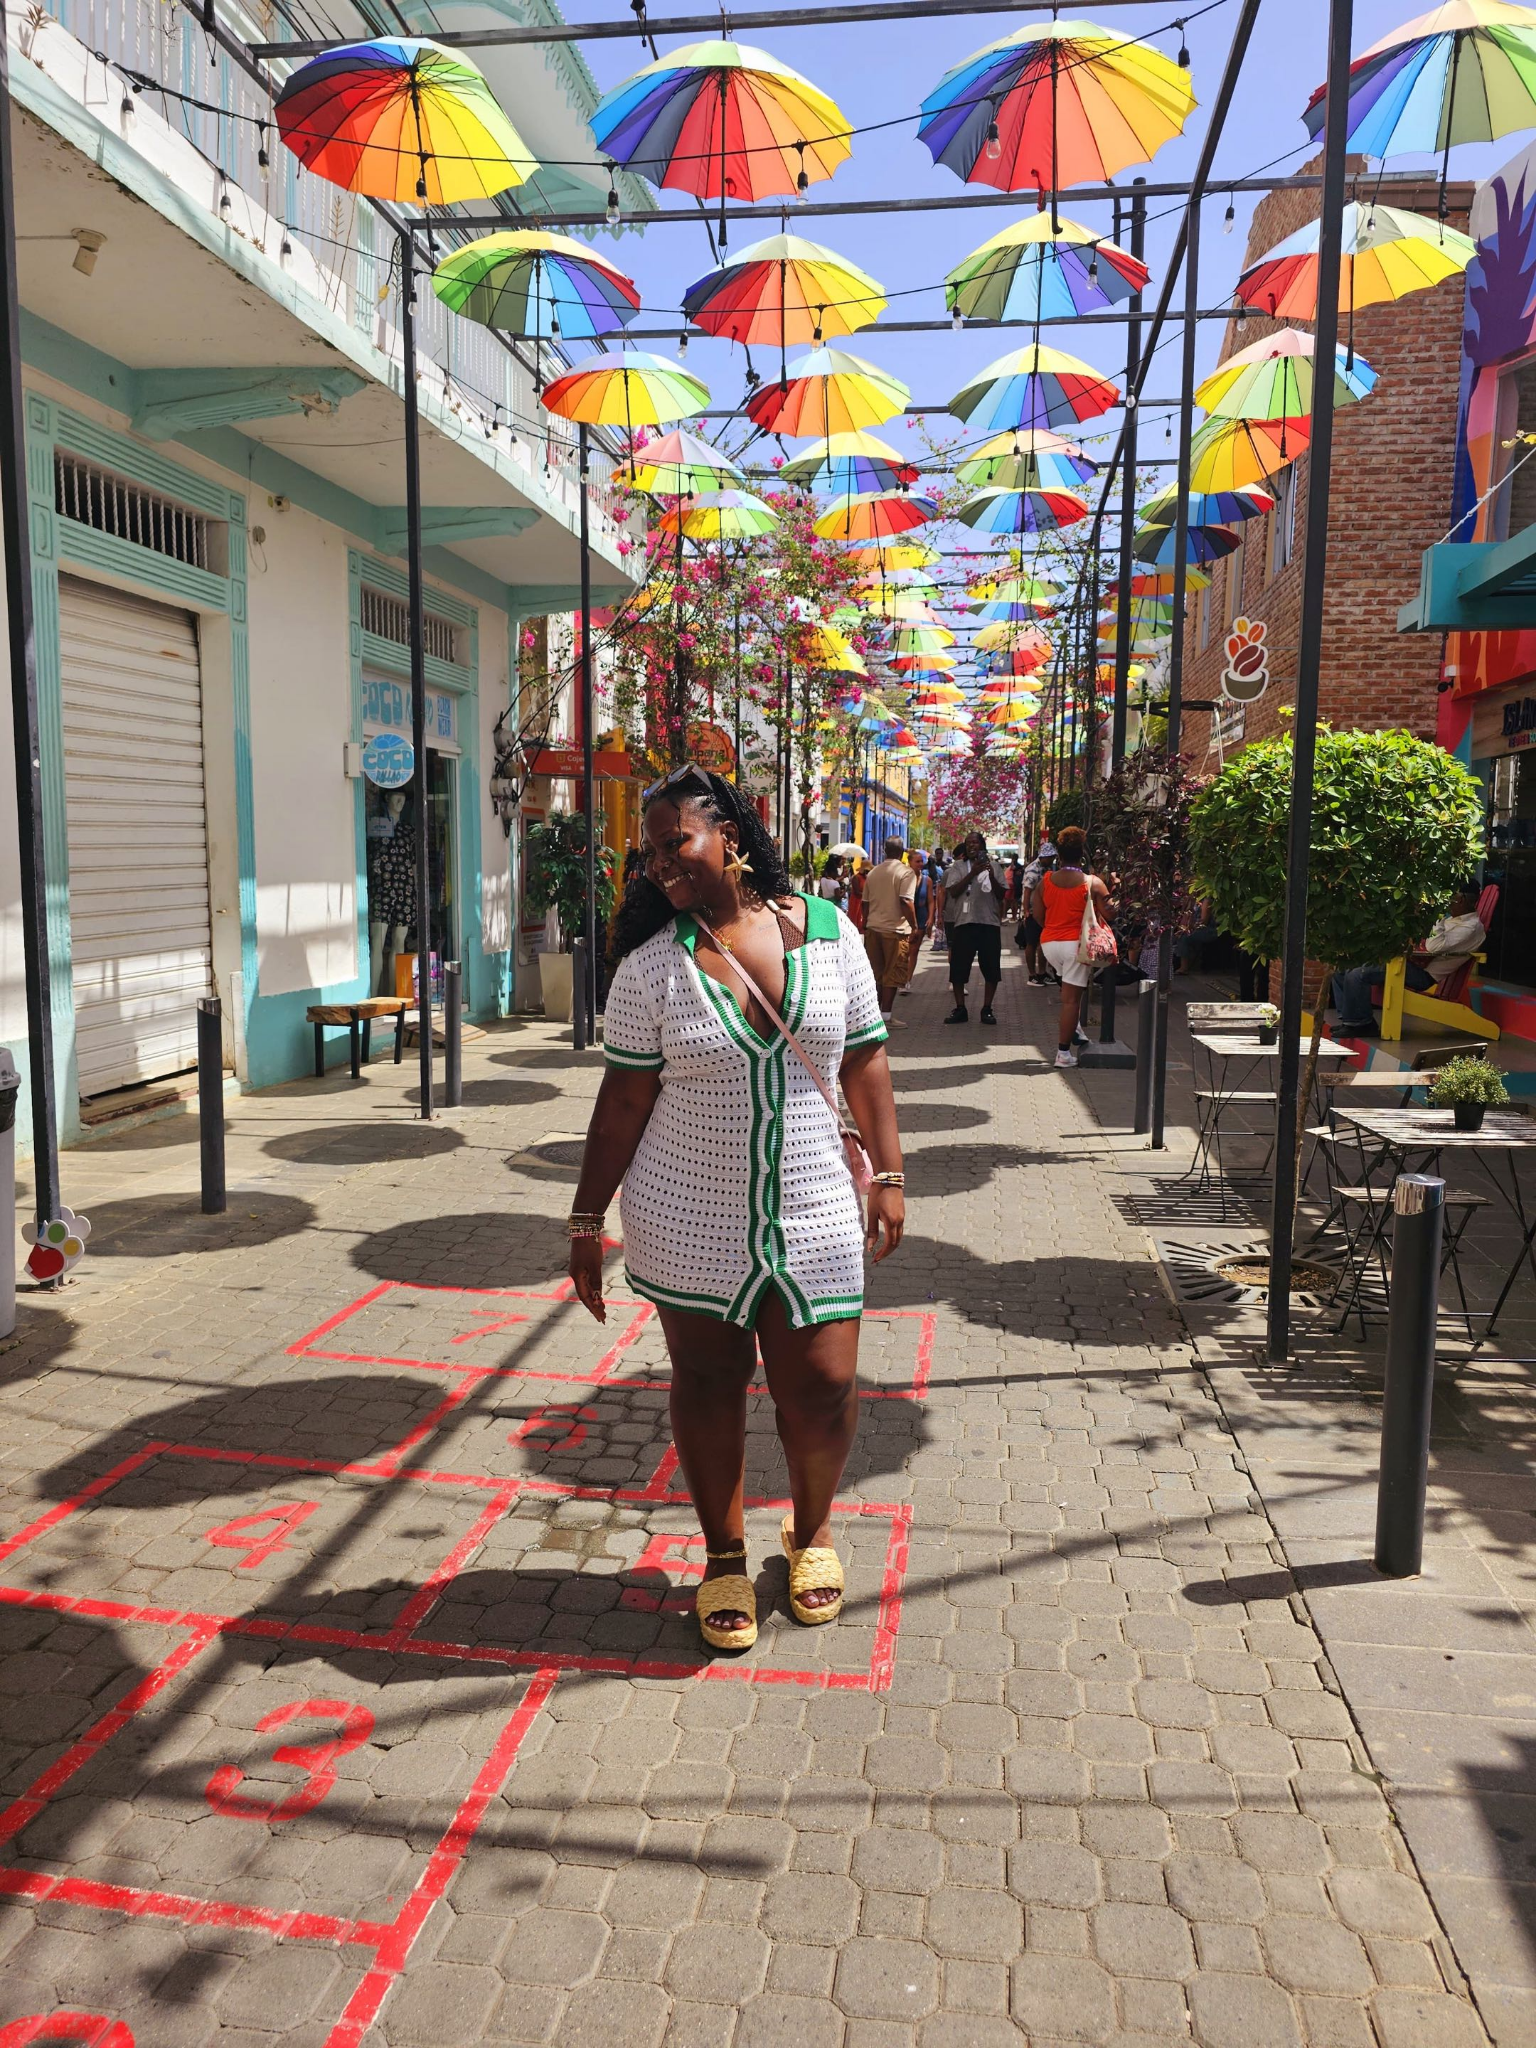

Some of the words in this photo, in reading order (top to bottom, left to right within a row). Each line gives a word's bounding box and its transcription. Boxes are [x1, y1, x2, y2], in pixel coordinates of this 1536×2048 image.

[363, 750, 414, 770] COCO
[567, 754, 585, 763] Caje
[450, 1309, 530, 1345] 7
[506, 1404, 599, 1452] 6
[204, 1502, 321, 1569] 4
[205, 1699, 376, 1822] 3
